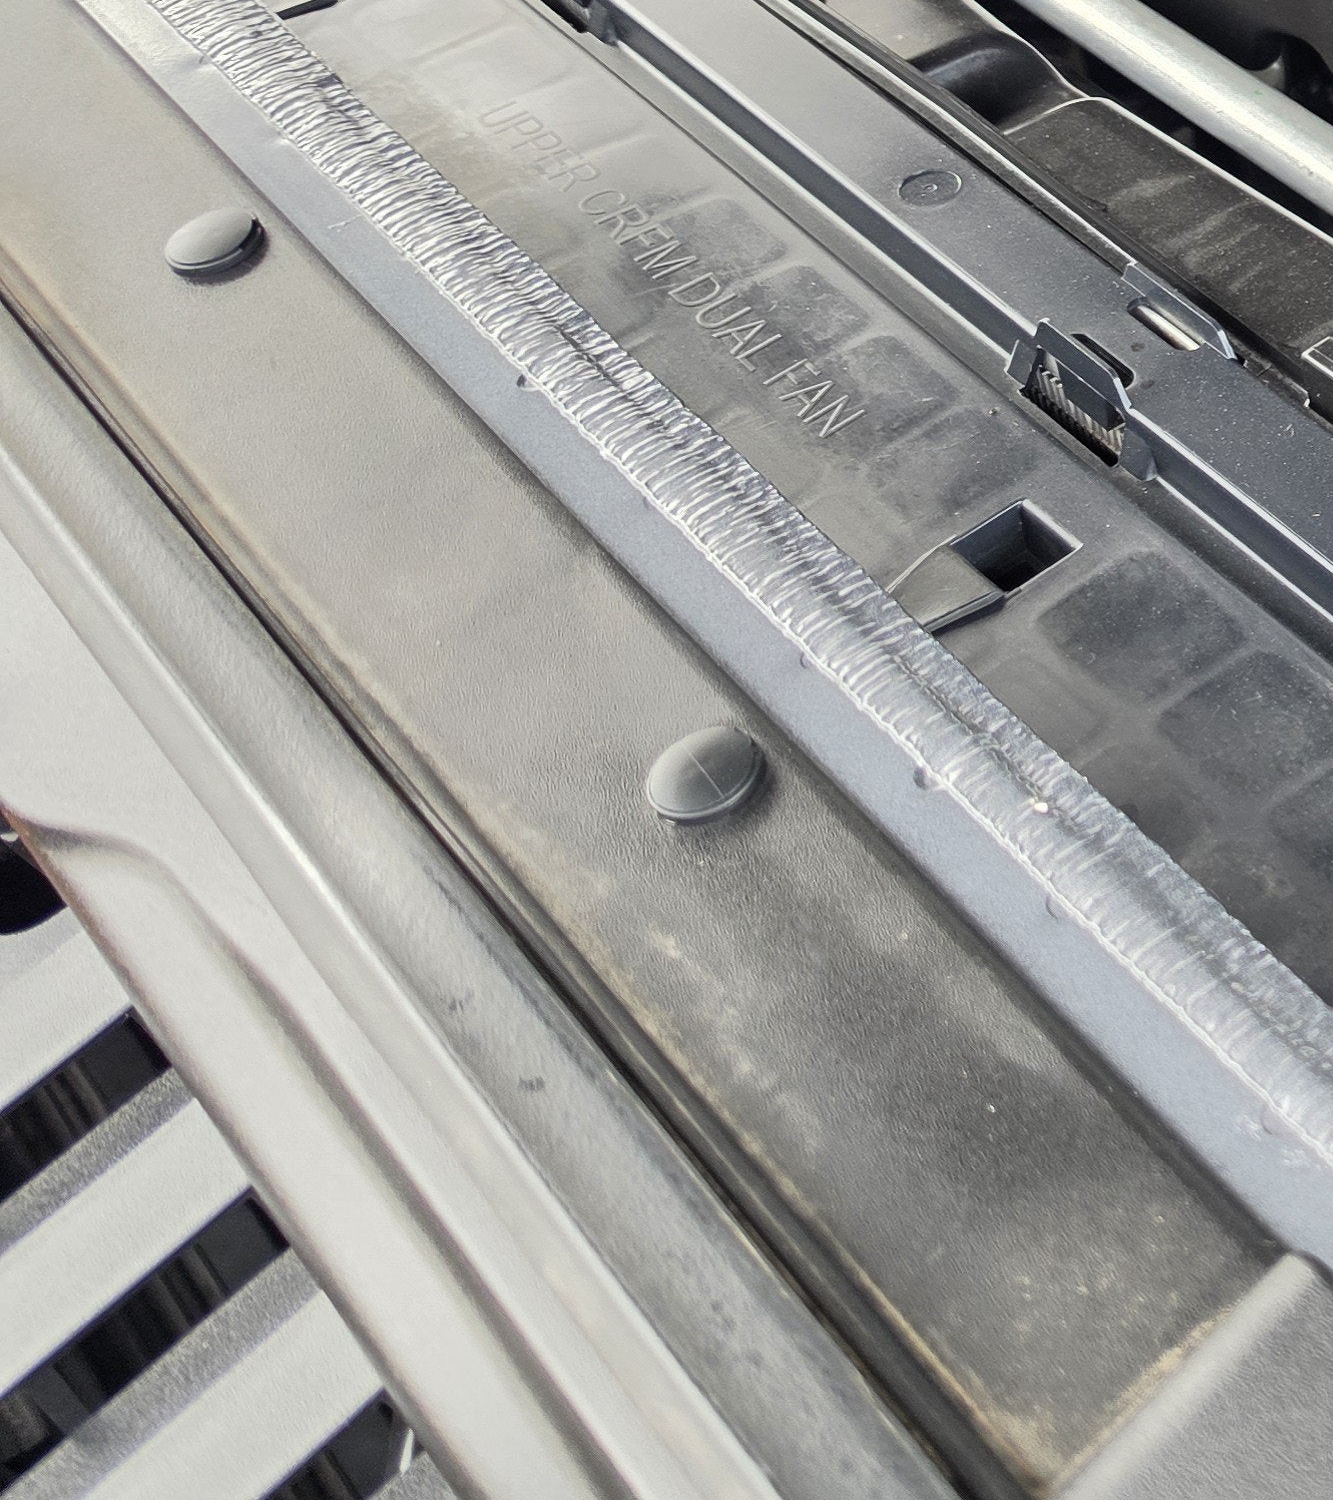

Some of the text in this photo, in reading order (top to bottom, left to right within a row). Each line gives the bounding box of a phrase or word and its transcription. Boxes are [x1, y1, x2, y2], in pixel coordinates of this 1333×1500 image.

[479, 100, 867, 439] UPPER CRFM DUAL FAN
